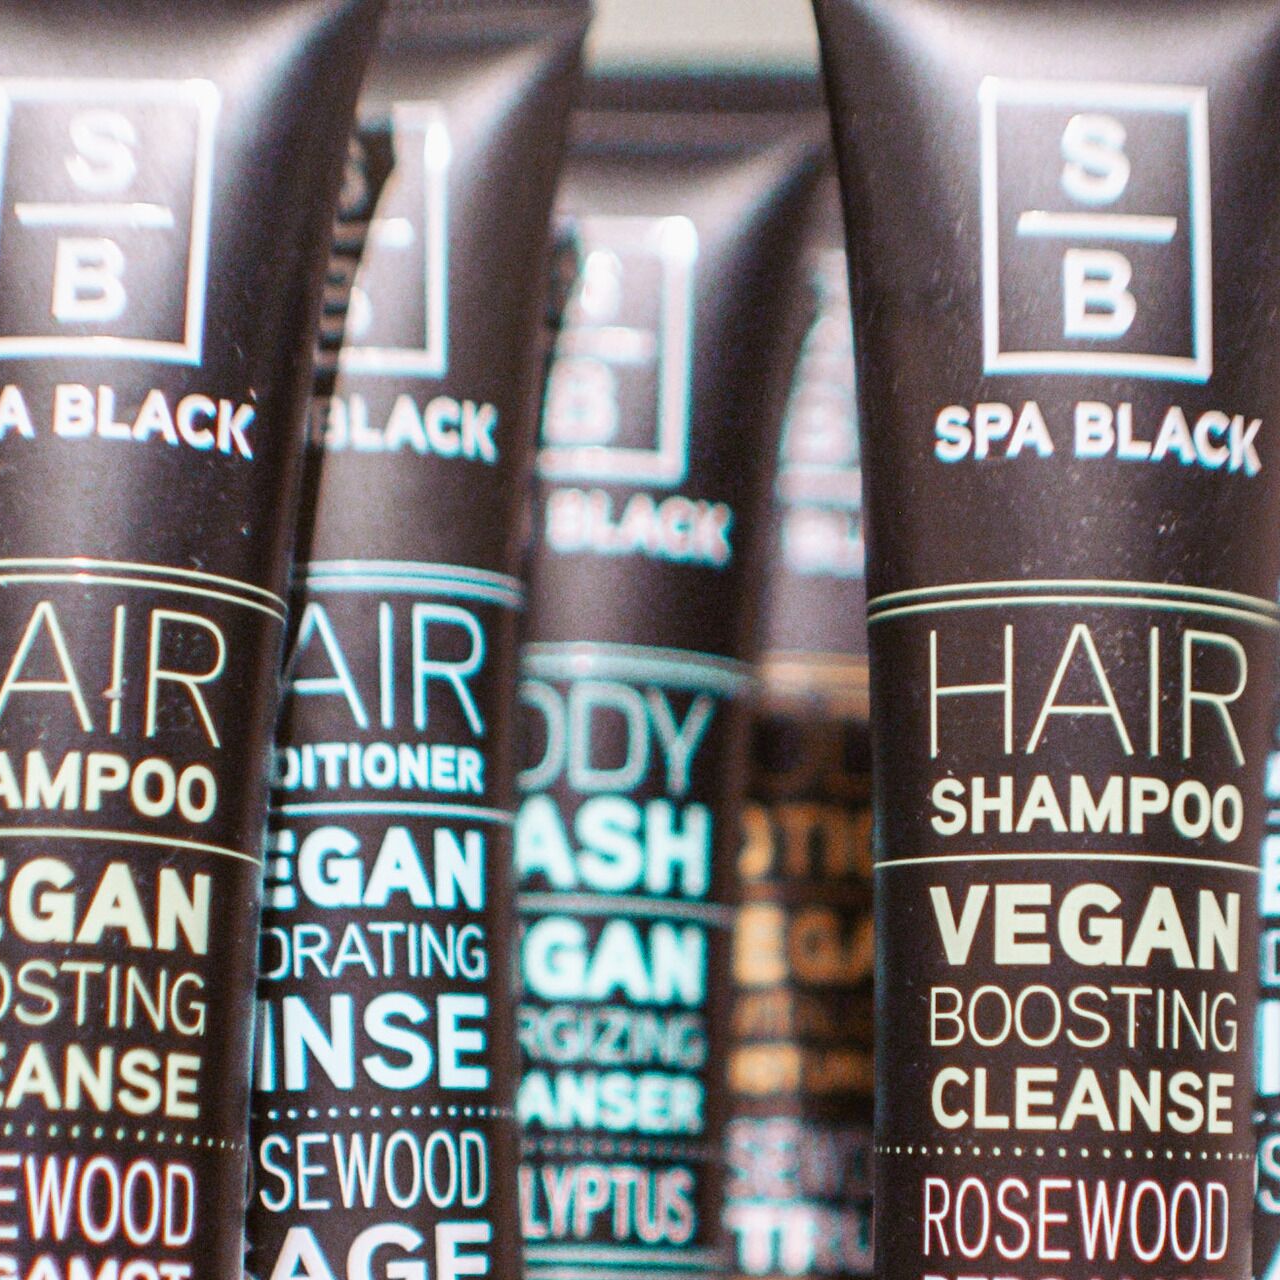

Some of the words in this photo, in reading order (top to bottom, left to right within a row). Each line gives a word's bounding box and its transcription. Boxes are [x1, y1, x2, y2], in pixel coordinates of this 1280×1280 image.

[64, 109, 137, 194] S
[1061, 111, 1131, 206] S
[51, 236, 128, 323] B
[1062, 247, 1137, 340] B
[52, 382, 257, 461] BLACK
[542, 356, 616, 446] B
[933, 400, 1054, 464] SPA
[1073, 400, 1264, 478] BLACK
[544, 488, 733, 568] BLACK
[929, 623, 1249, 766] HAIR
[930, 774, 1244, 842] SHAMPOO
[928, 883, 1242, 973] VEGAN
[929, 984, 1239, 1053] BOOSTING
[930, 1066, 1235, 1134] CLEANSE
[922, 1176, 1230, 1262] ROSEWOOD
